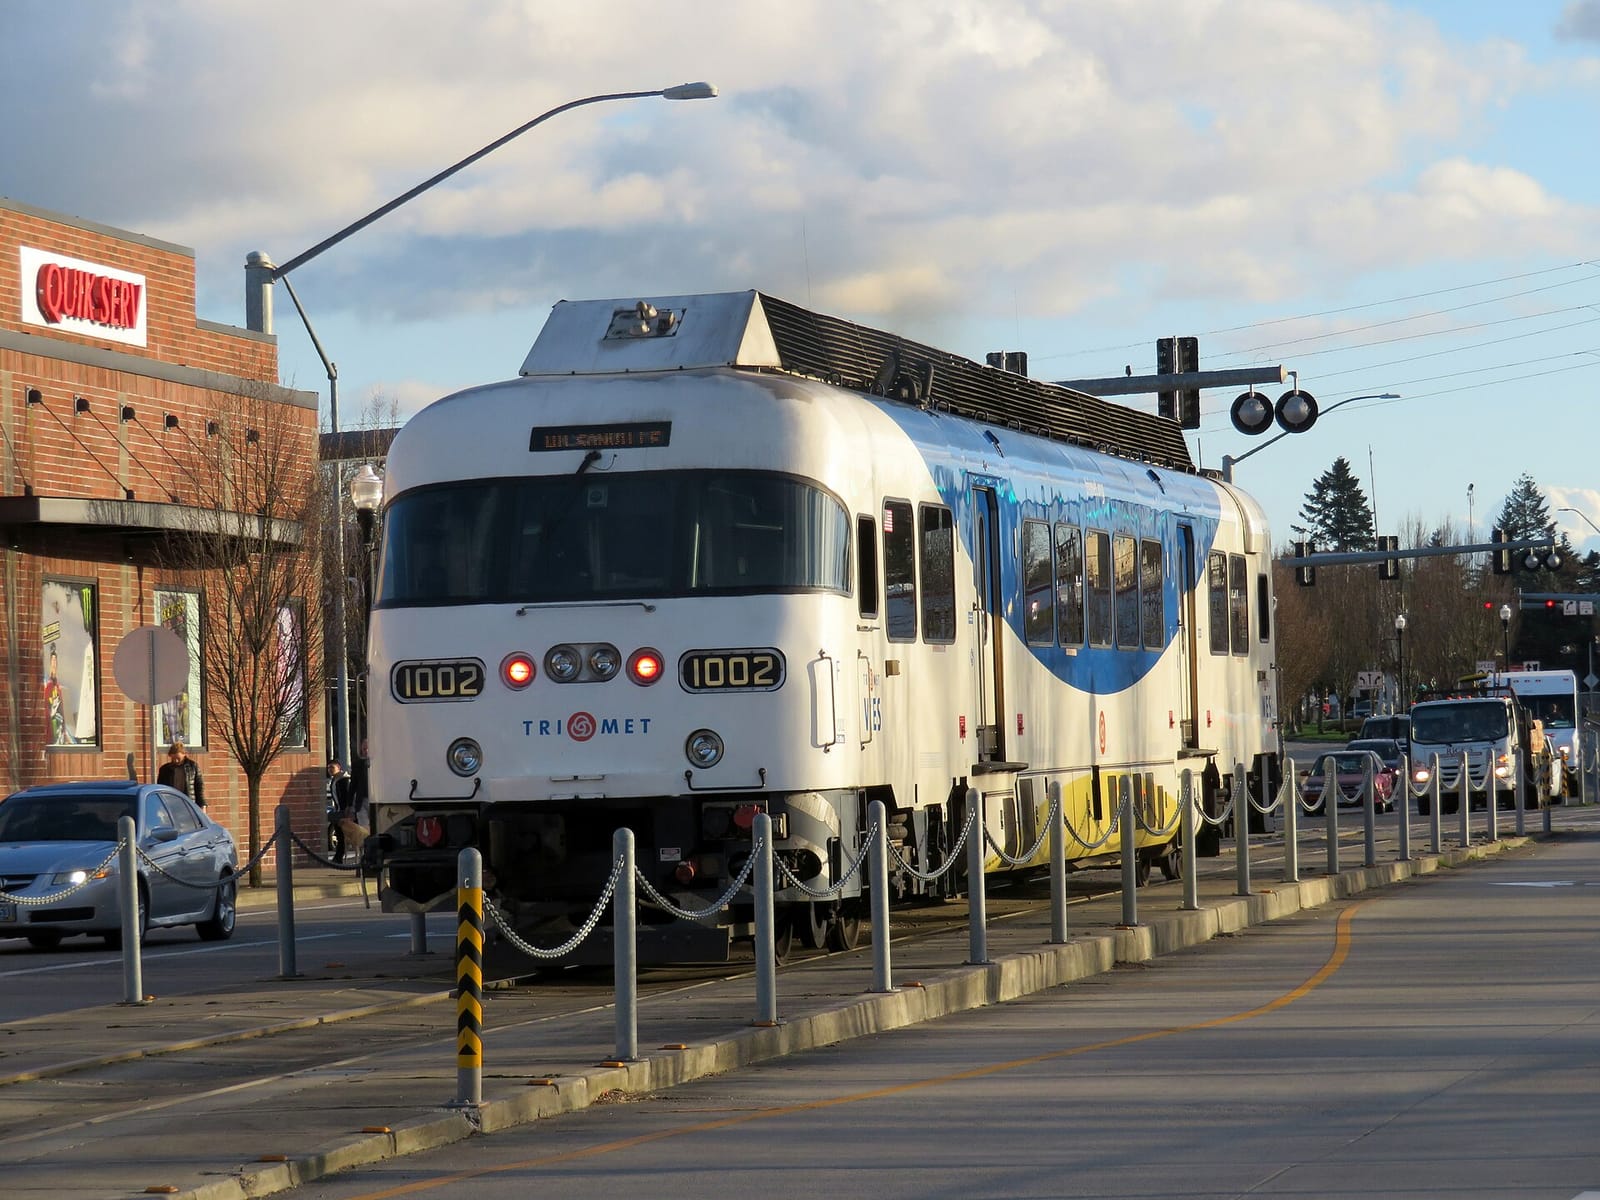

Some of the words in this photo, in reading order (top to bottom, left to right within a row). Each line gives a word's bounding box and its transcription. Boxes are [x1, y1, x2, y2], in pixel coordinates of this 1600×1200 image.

[37, 263, 96, 324] QUIK
[99, 275, 142, 329] SERV
[404, 666, 478, 697] 1002
[693, 656, 774, 687] 1002
